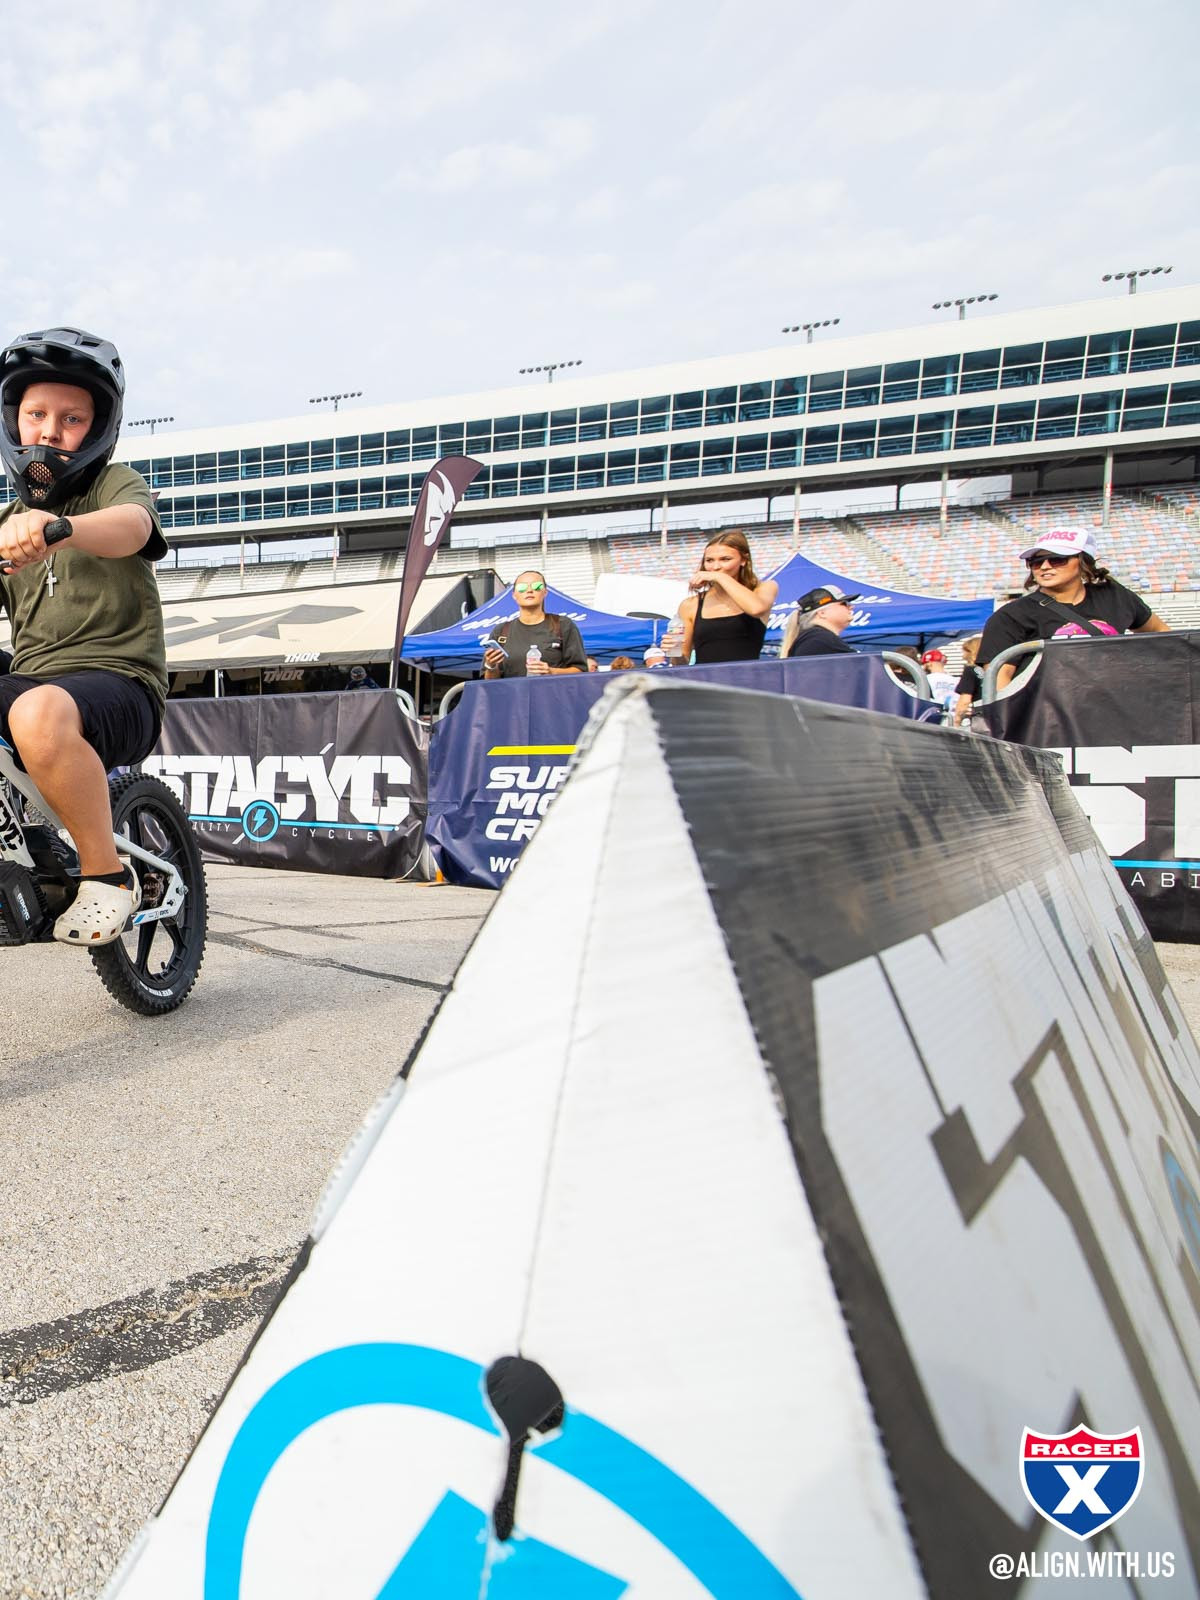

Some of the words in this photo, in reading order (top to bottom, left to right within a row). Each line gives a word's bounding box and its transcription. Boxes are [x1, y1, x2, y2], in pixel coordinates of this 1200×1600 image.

[284, 652, 321, 663] THOR
[263, 669, 305, 683] THOR
[141, 755, 411, 824] STACYC
[291, 828, 374, 842] CYCLE
